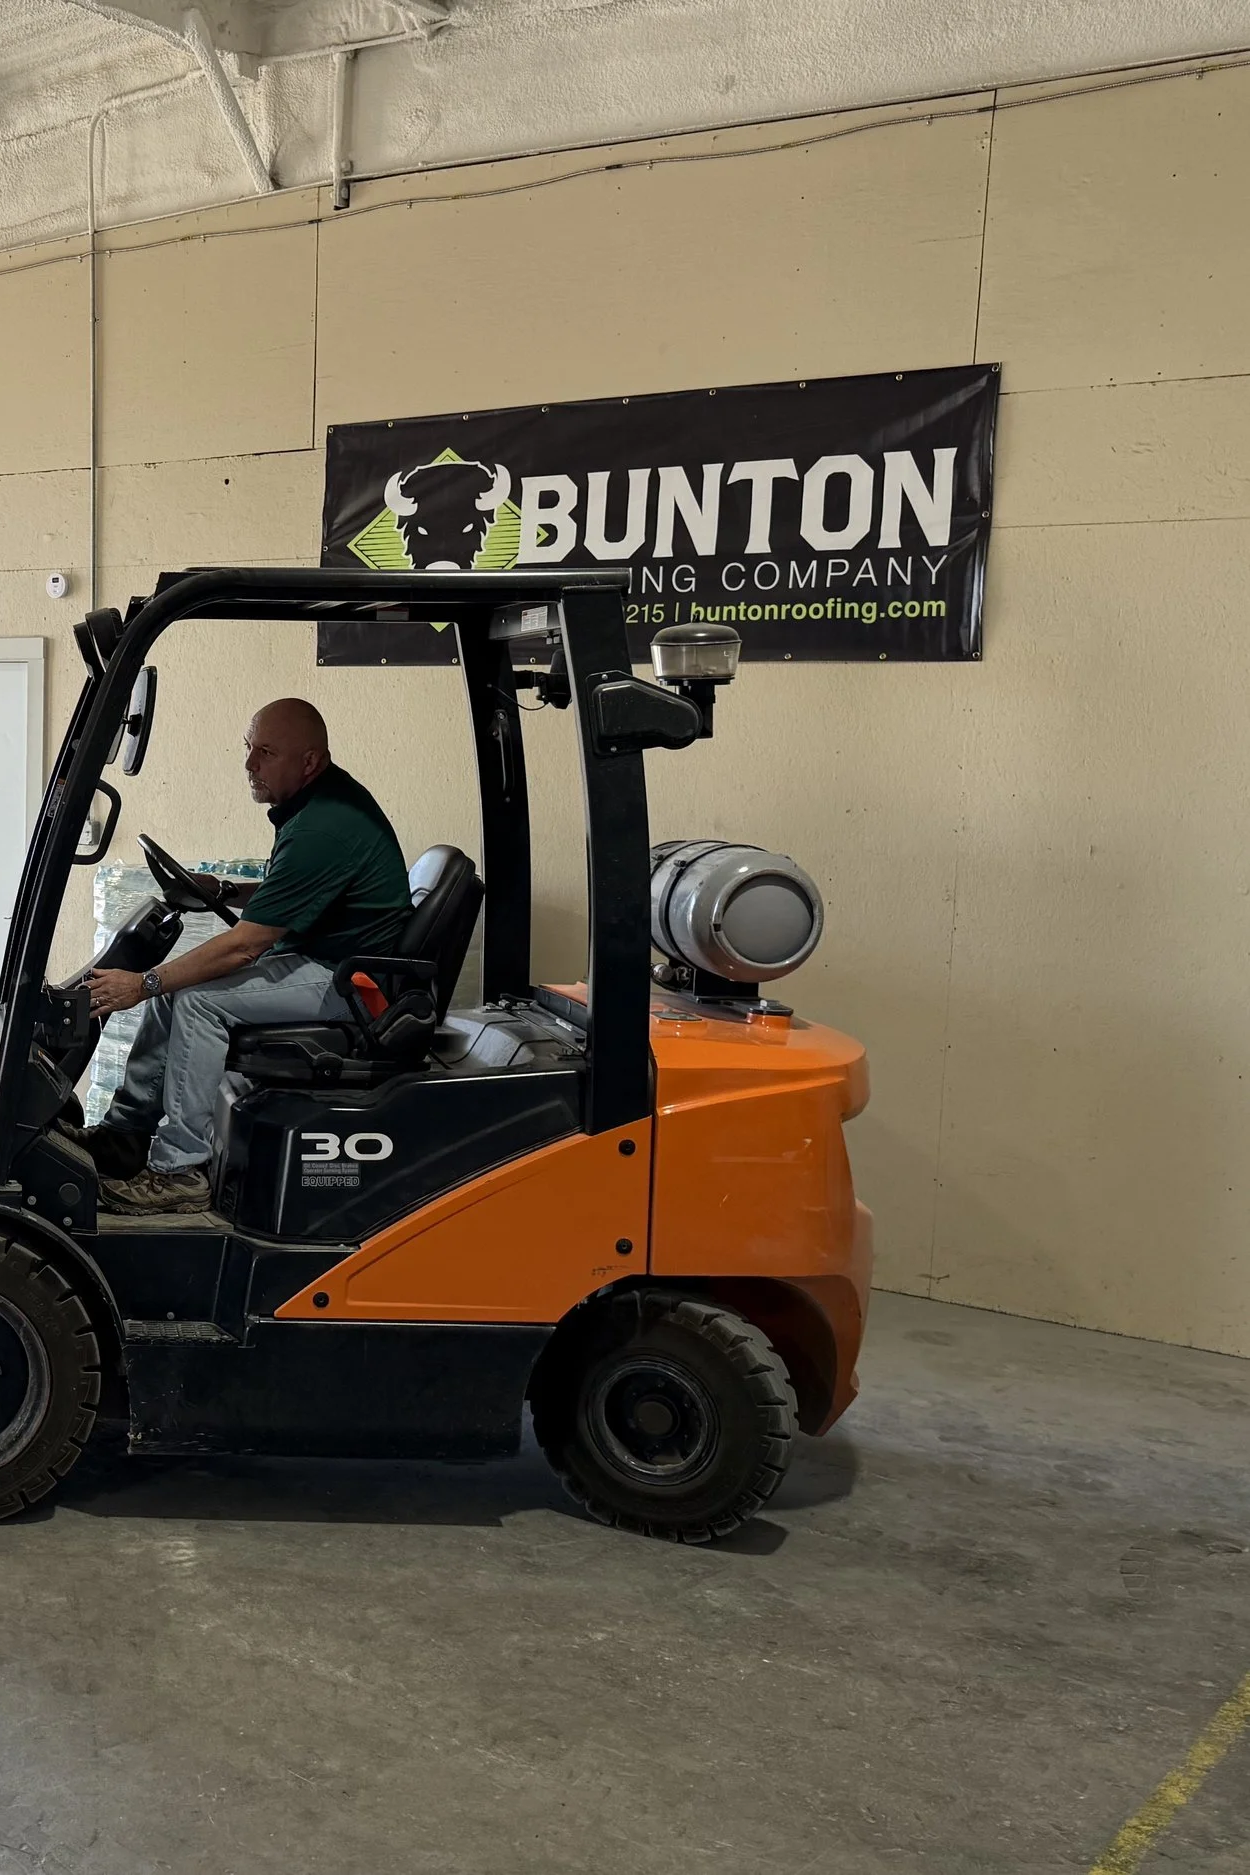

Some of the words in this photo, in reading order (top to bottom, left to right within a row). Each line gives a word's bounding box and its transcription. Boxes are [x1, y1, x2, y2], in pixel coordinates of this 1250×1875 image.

[516, 447, 958, 564] BUNTON
[627, 565, 696, 594] ING
[721, 554, 948, 591] COMPANY
[622, 603, 665, 624] 215
[301, 1132, 394, 1161] 30
[301, 1176, 360, 1187] EQUIPPED
